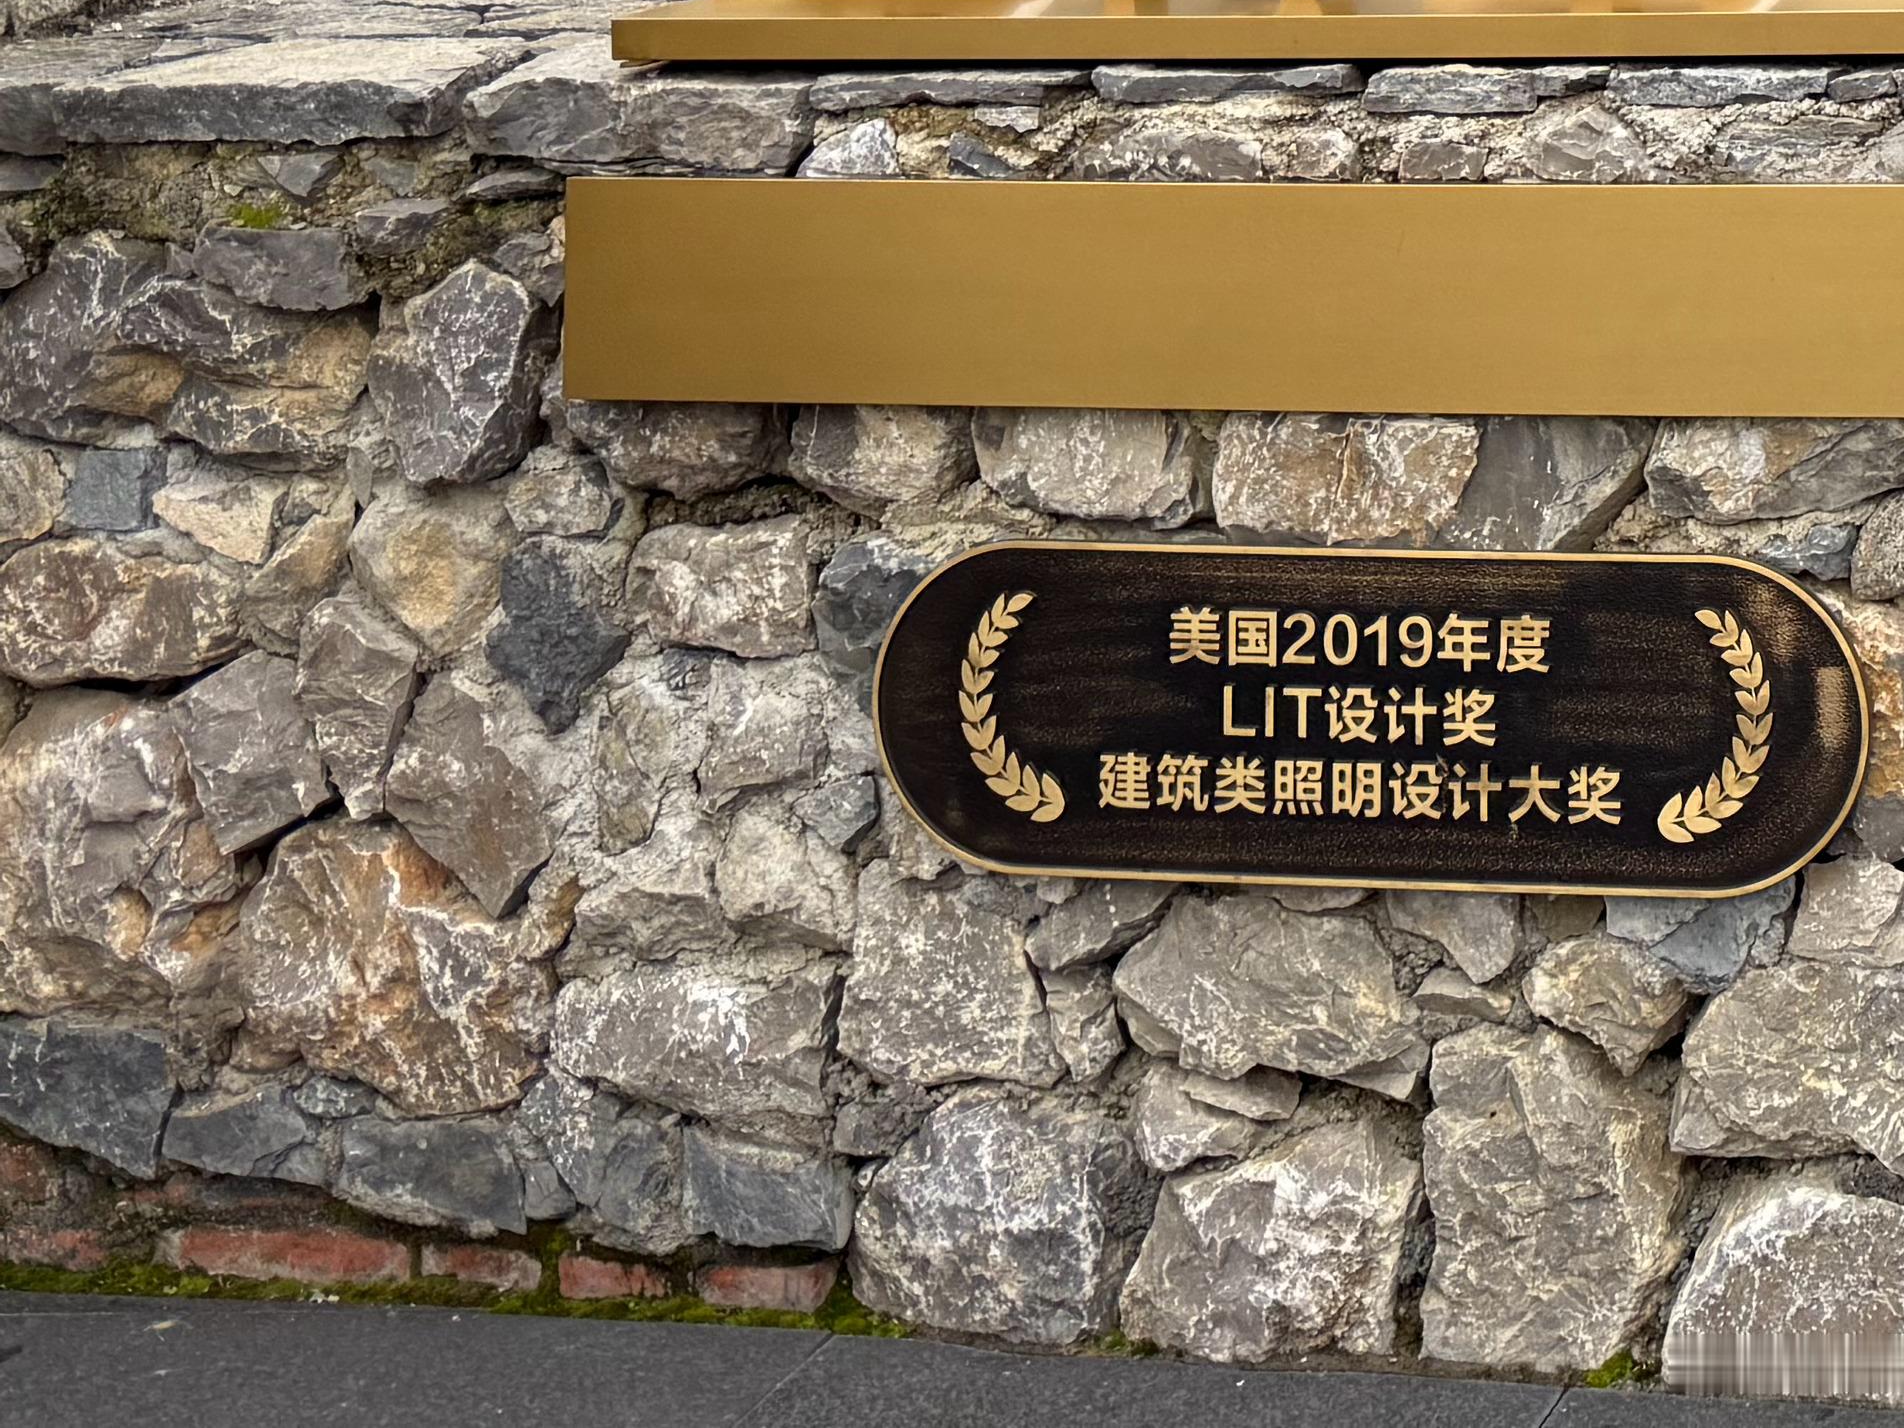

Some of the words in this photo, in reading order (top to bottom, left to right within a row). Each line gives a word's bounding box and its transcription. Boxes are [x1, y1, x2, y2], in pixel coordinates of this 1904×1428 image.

[1168, 606, 1551, 675] 美国2019年度
[1222, 684, 1498, 747] LIT设计奖
[1098, 752, 1624, 825] 建筑类照明设计大奖
